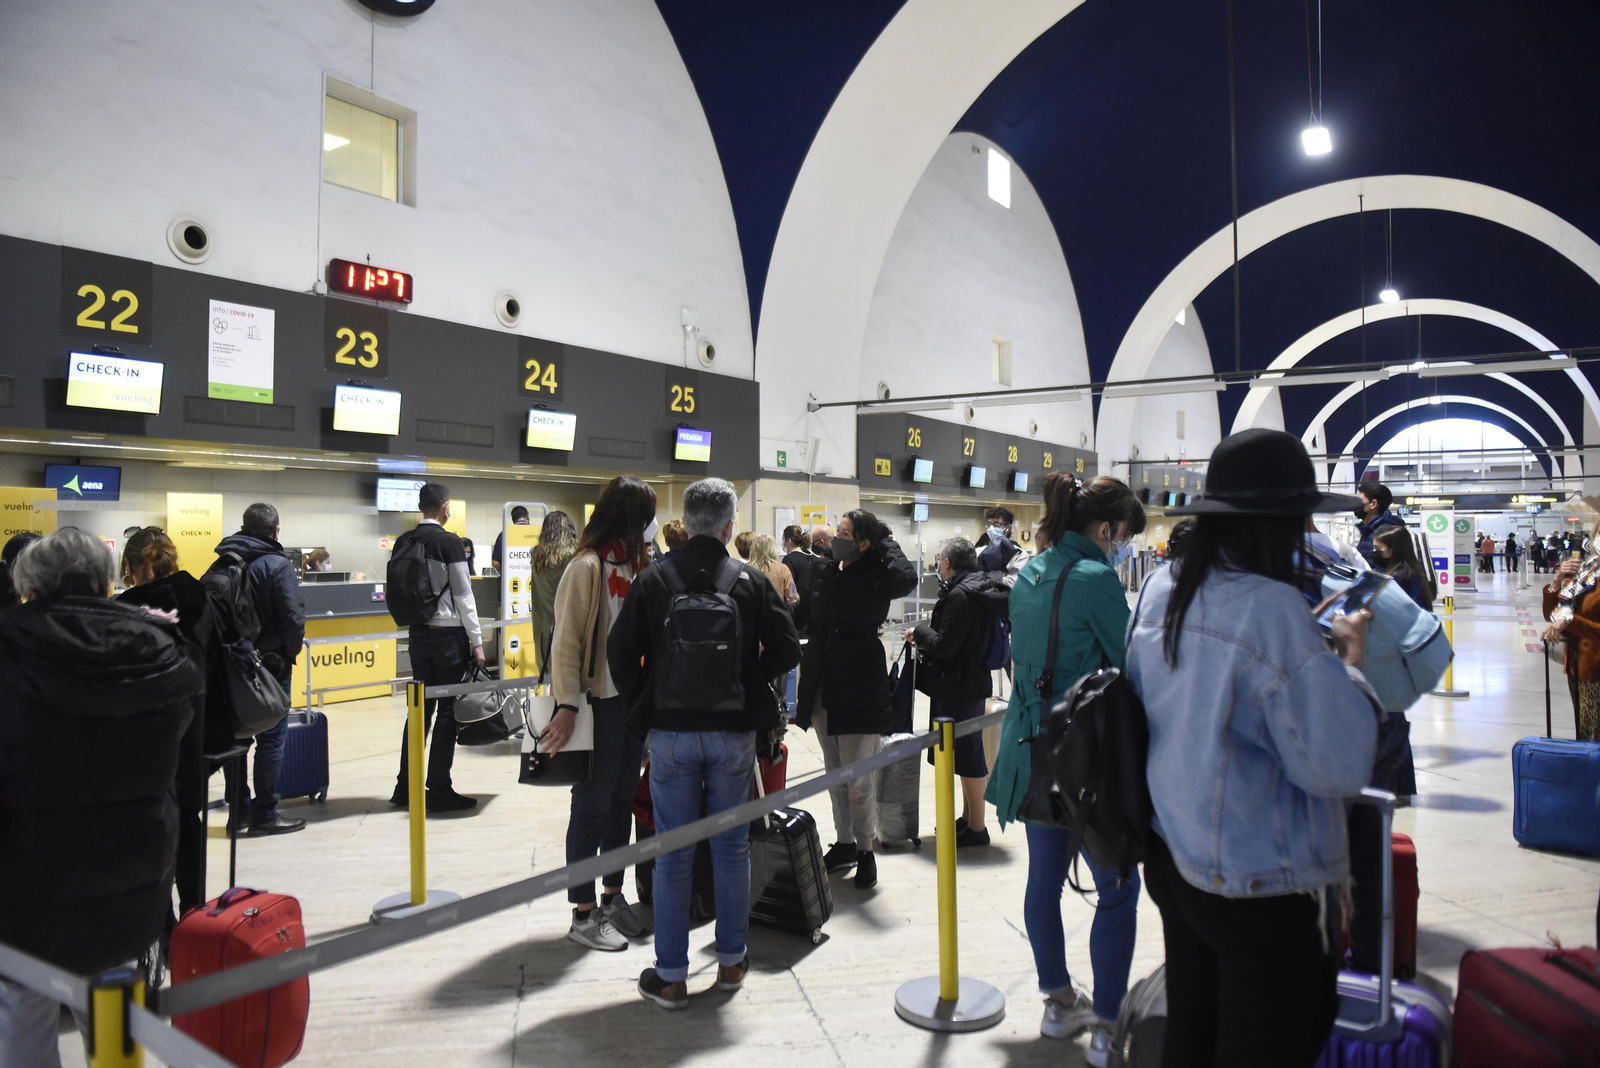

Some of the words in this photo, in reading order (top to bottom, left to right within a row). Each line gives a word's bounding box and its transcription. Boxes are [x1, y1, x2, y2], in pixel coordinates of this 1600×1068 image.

[76, 284, 139, 334] 22
[213, 306, 226, 314] info
[229, 310, 255, 319] COVID-19
[335, 327, 379, 369] 23
[76, 362, 139, 378] CHECK-IN
[525, 359, 558, 394] 24
[115, 392, 153, 407] vueling
[340, 393, 385, 405] CHECKIN
[671, 385, 695, 414] 25
[532, 416, 565, 426] CHECK-IN
[679, 432, 703, 442] PREMIUM
[908, 427, 921, 448] 26
[964, 437, 975, 456] 27
[1008, 445, 1018, 463] 28
[1043, 452, 1052, 468] 29
[1076, 458, 1084, 473] 30
[82, 481, 103, 490] aena
[180, 507, 210, 517] vueling
[311, 646, 375, 668] vueling
